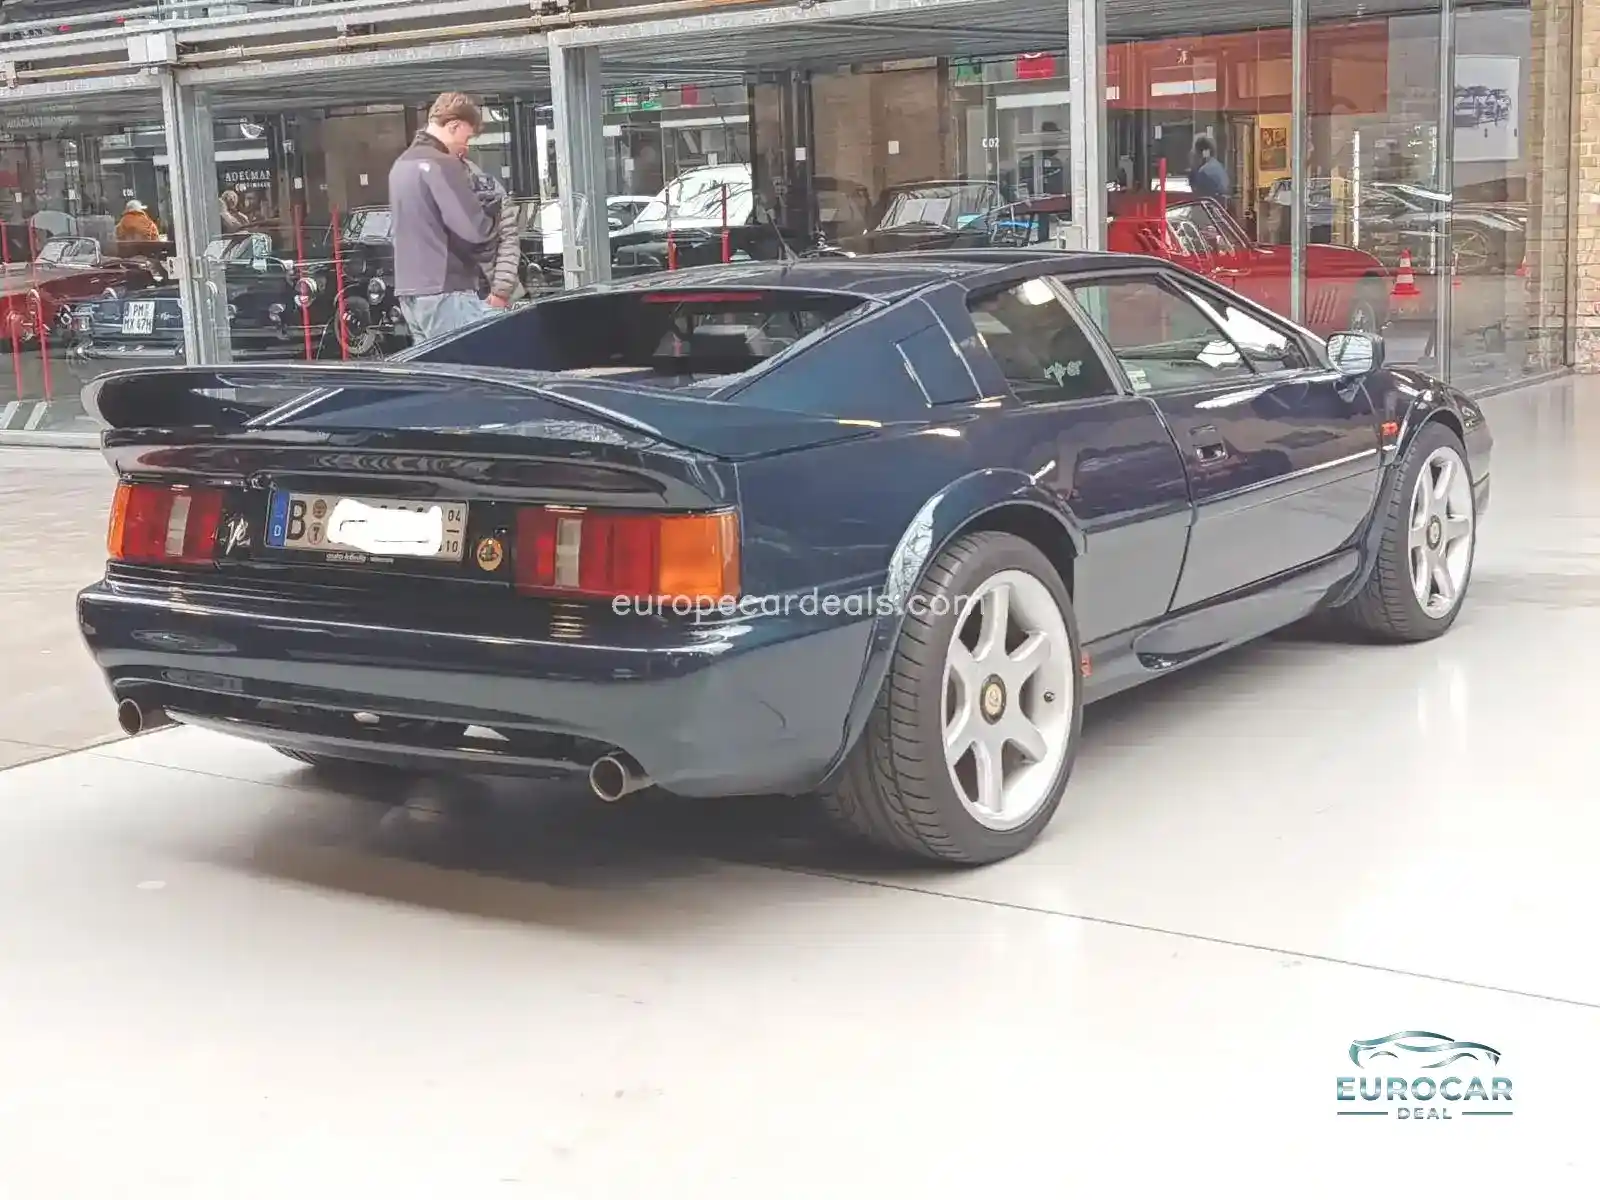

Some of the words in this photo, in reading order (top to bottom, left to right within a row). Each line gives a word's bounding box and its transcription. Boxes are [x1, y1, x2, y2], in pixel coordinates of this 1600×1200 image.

[286, 500, 307, 540] B
[447, 509, 461, 522] 04
[445, 540, 459, 553] 10
